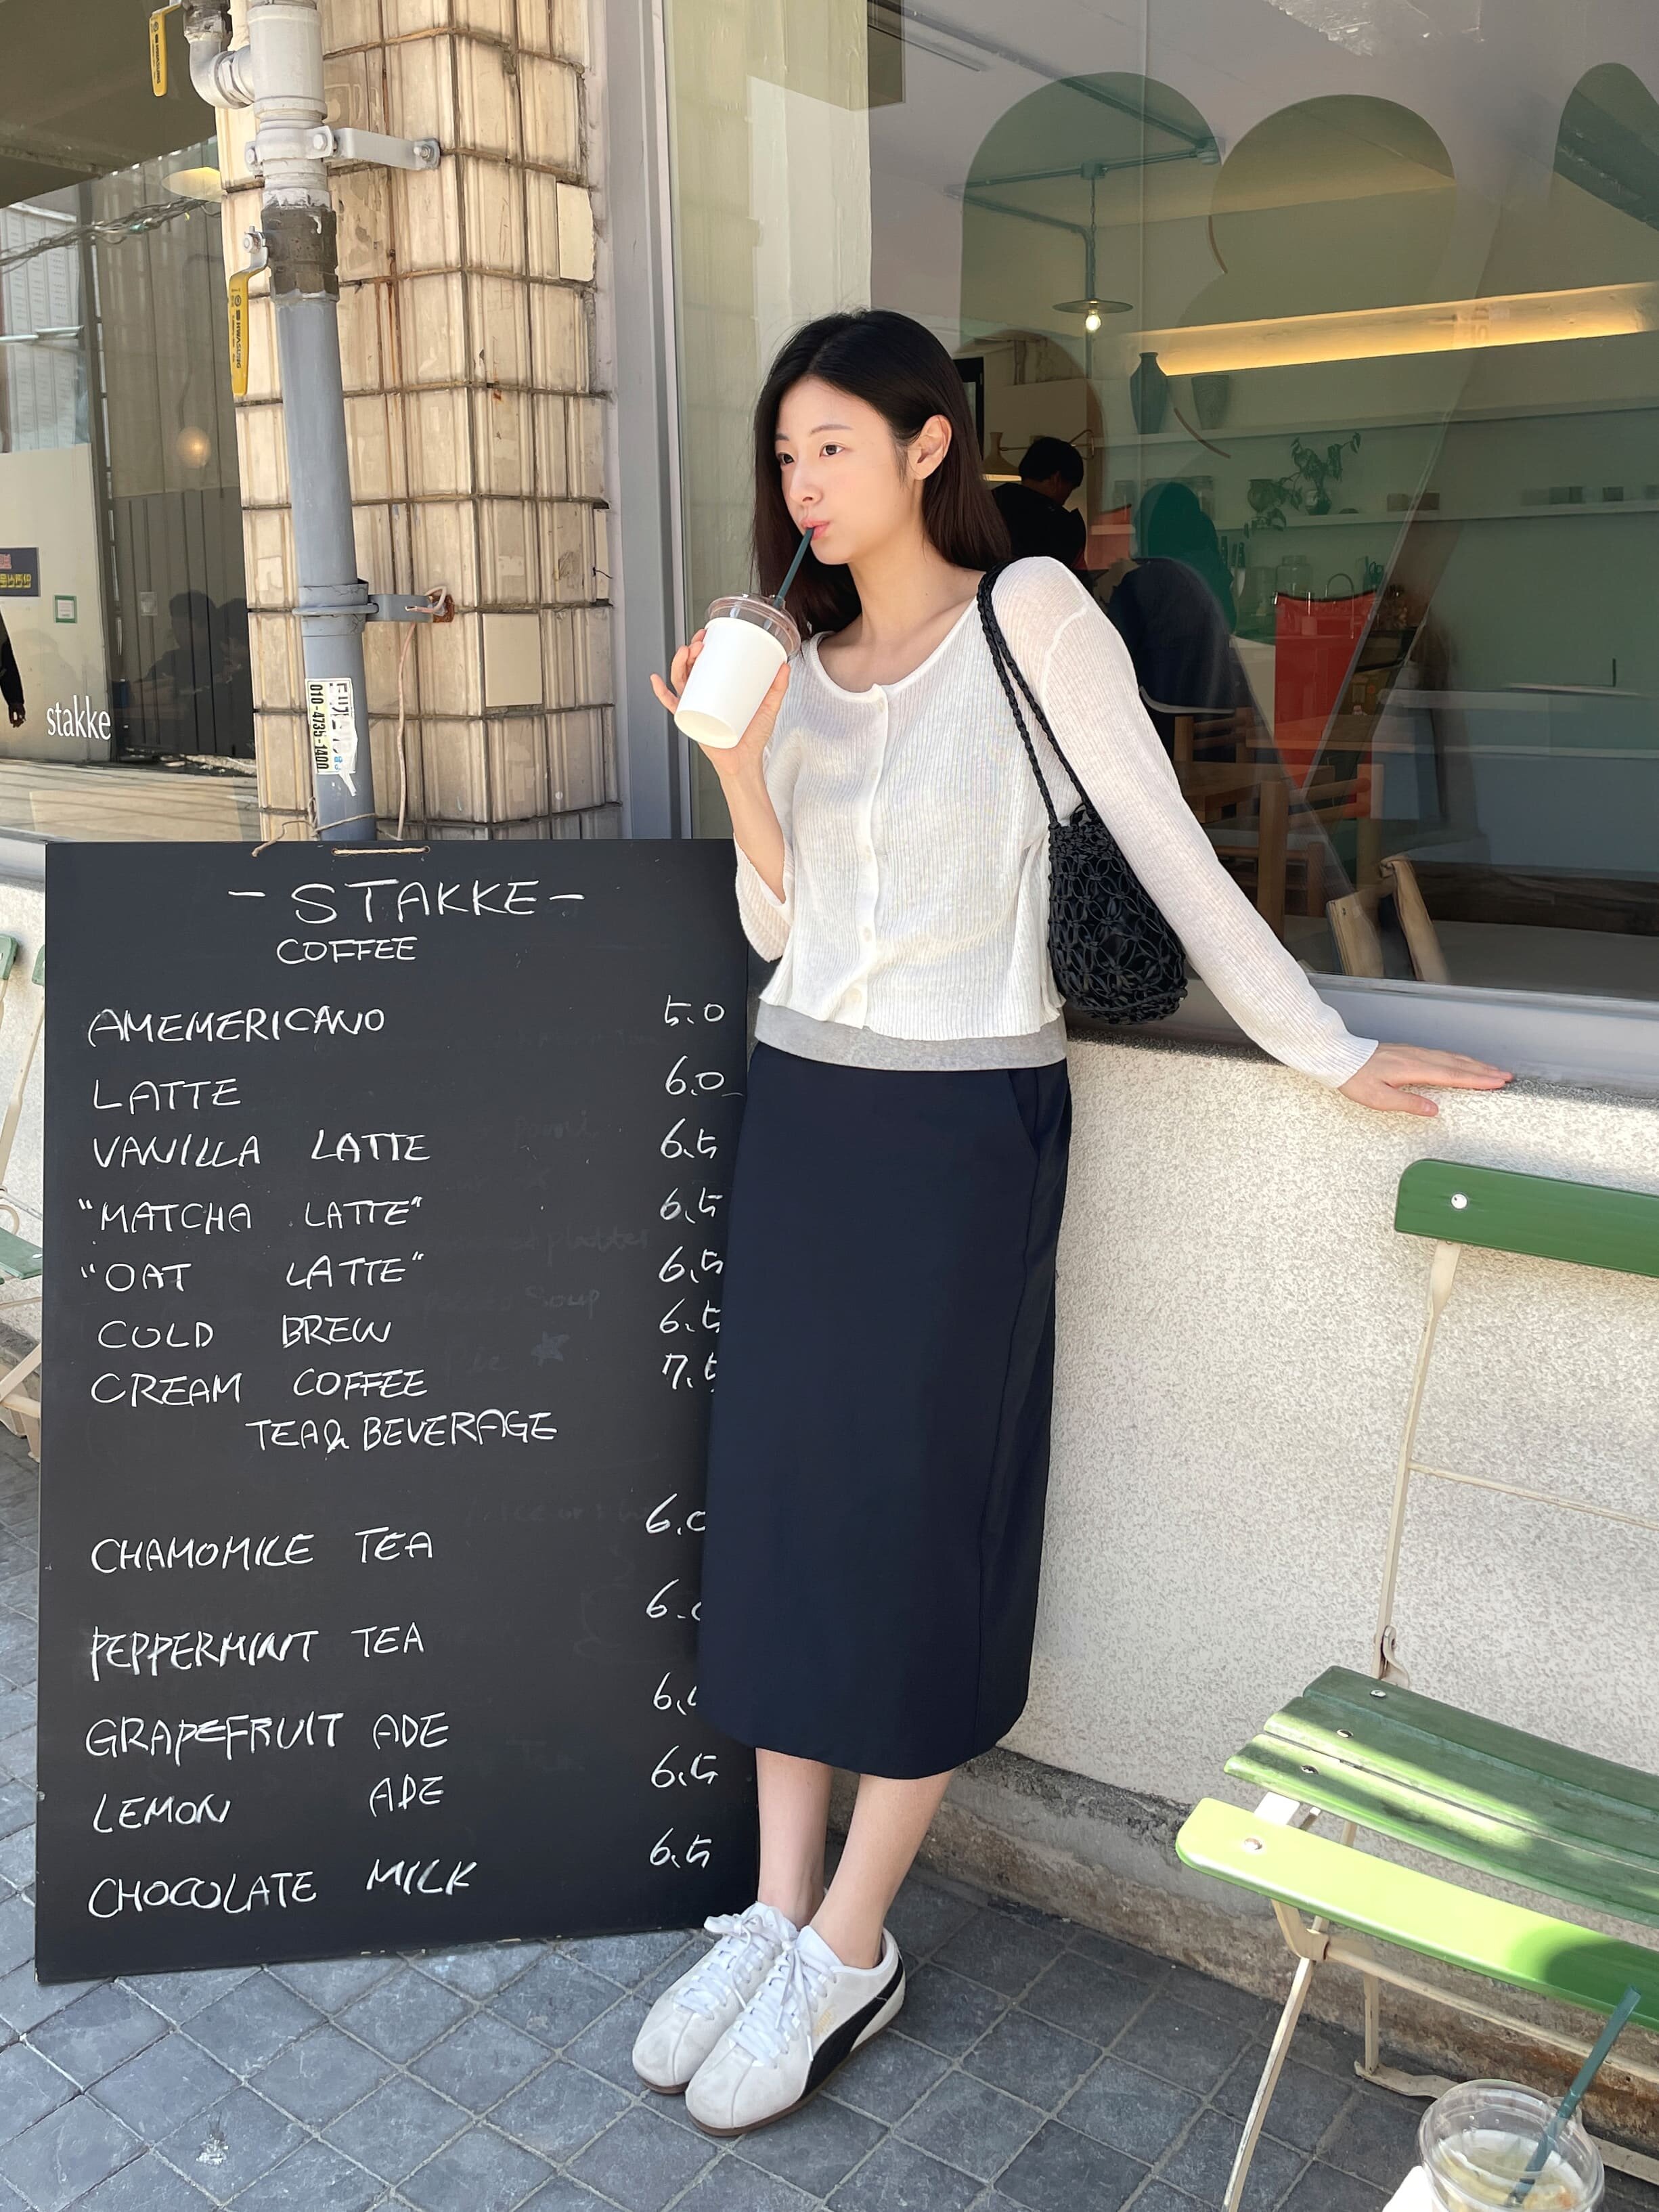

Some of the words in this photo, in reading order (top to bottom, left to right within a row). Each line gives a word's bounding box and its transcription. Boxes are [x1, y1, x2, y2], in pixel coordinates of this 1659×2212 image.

[47, 694, 111, 740] stakke
[309, 684, 330, 770] 010-4735-1400
[276, 936, 418, 965] COFFEE
[87, 1005, 384, 1048] AMEMERICANO
[664, 994, 725, 1027] 5.0
[93, 1078, 241, 1115] LATTE
[665, 1055, 724, 1096] 6.0
[93, 1133, 261, 1168] VANILLA
[311, 1129, 430, 1164] LATTE
[660, 1118, 717, 1159] 6.5
[659, 1187, 723, 1224] 6.5
[97, 1320, 213, 1348] COLD
[282, 1314, 391, 1349] BREW
[91, 1372, 242, 1408] CREAM
[293, 1367, 428, 1401] COFFEE
[363, 1409, 558, 1452] BEVERAGE
[91, 1533, 315, 1574] CHAMOMILE
[355, 1526, 433, 1564] TEA
[89, 1626, 319, 1682] PEPPERMINT
[351, 1622, 424, 1658] TEA
[85, 1710, 345, 1767] GRAPEFRUIT
[372, 1712, 449, 1750] ADE
[93, 1793, 231, 1834] LEMON
[369, 1773, 444, 1817] ADE
[650, 1745, 719, 1788] 6.5
[88, 1871, 317, 1918] CHOCOLATE
[366, 1859, 477, 1895] MILK
[649, 1828, 712, 1868] 6.5
